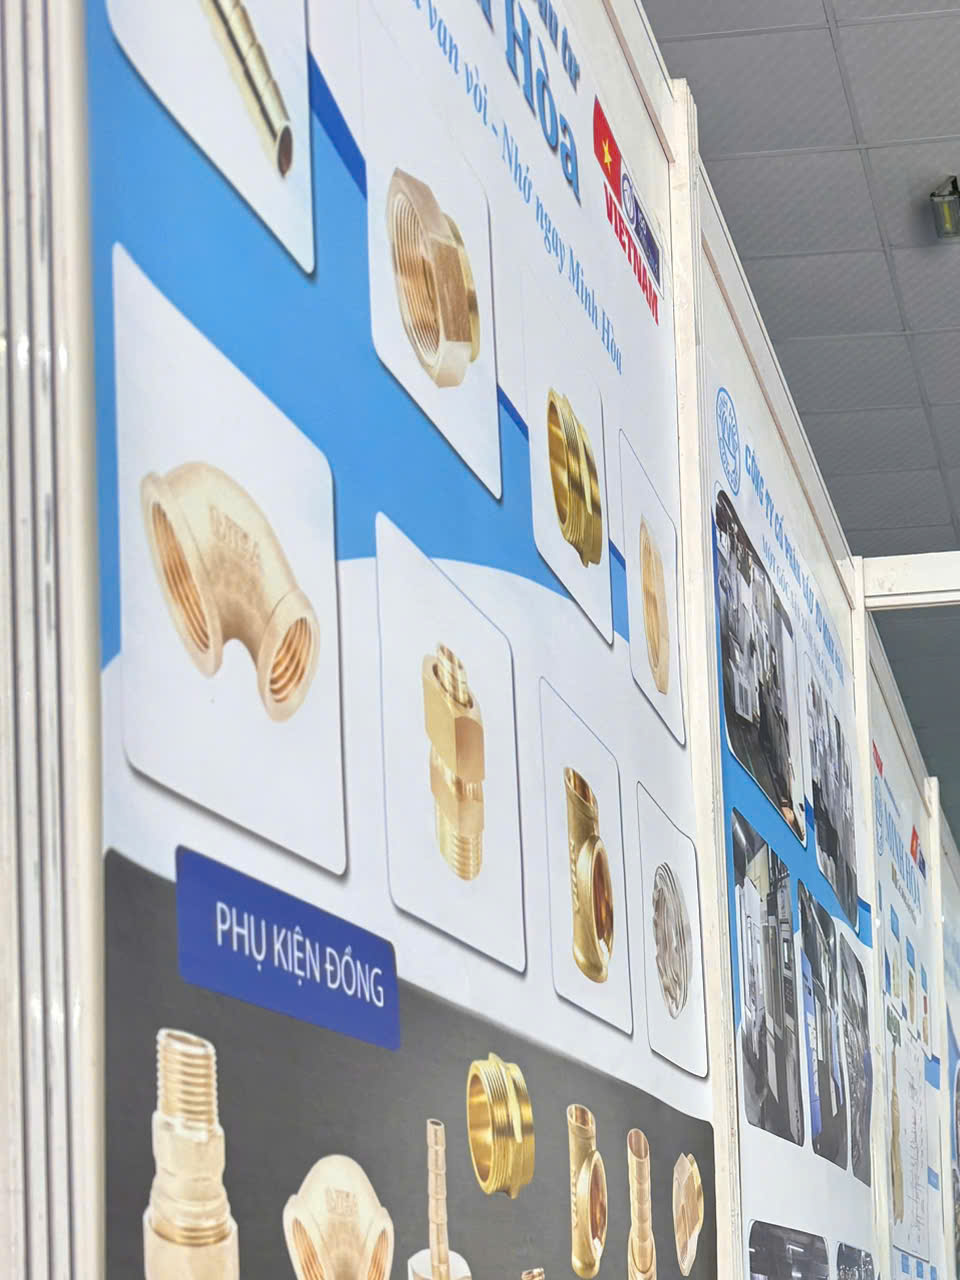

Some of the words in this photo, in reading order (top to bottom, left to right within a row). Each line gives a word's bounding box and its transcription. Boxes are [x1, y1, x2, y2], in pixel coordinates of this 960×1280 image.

[428, 0, 458, 75] van
[464, 62, 488, 127] vòi
[536, 194, 566, 275] ngay
[567, 244, 598, 331] Minh
[504, 0, 581, 208] Hòa
[603, 179, 659, 327] VIETNAM
[215, 901, 268, 973] PHỤ
[272, 924, 321, 987] KIỆN
